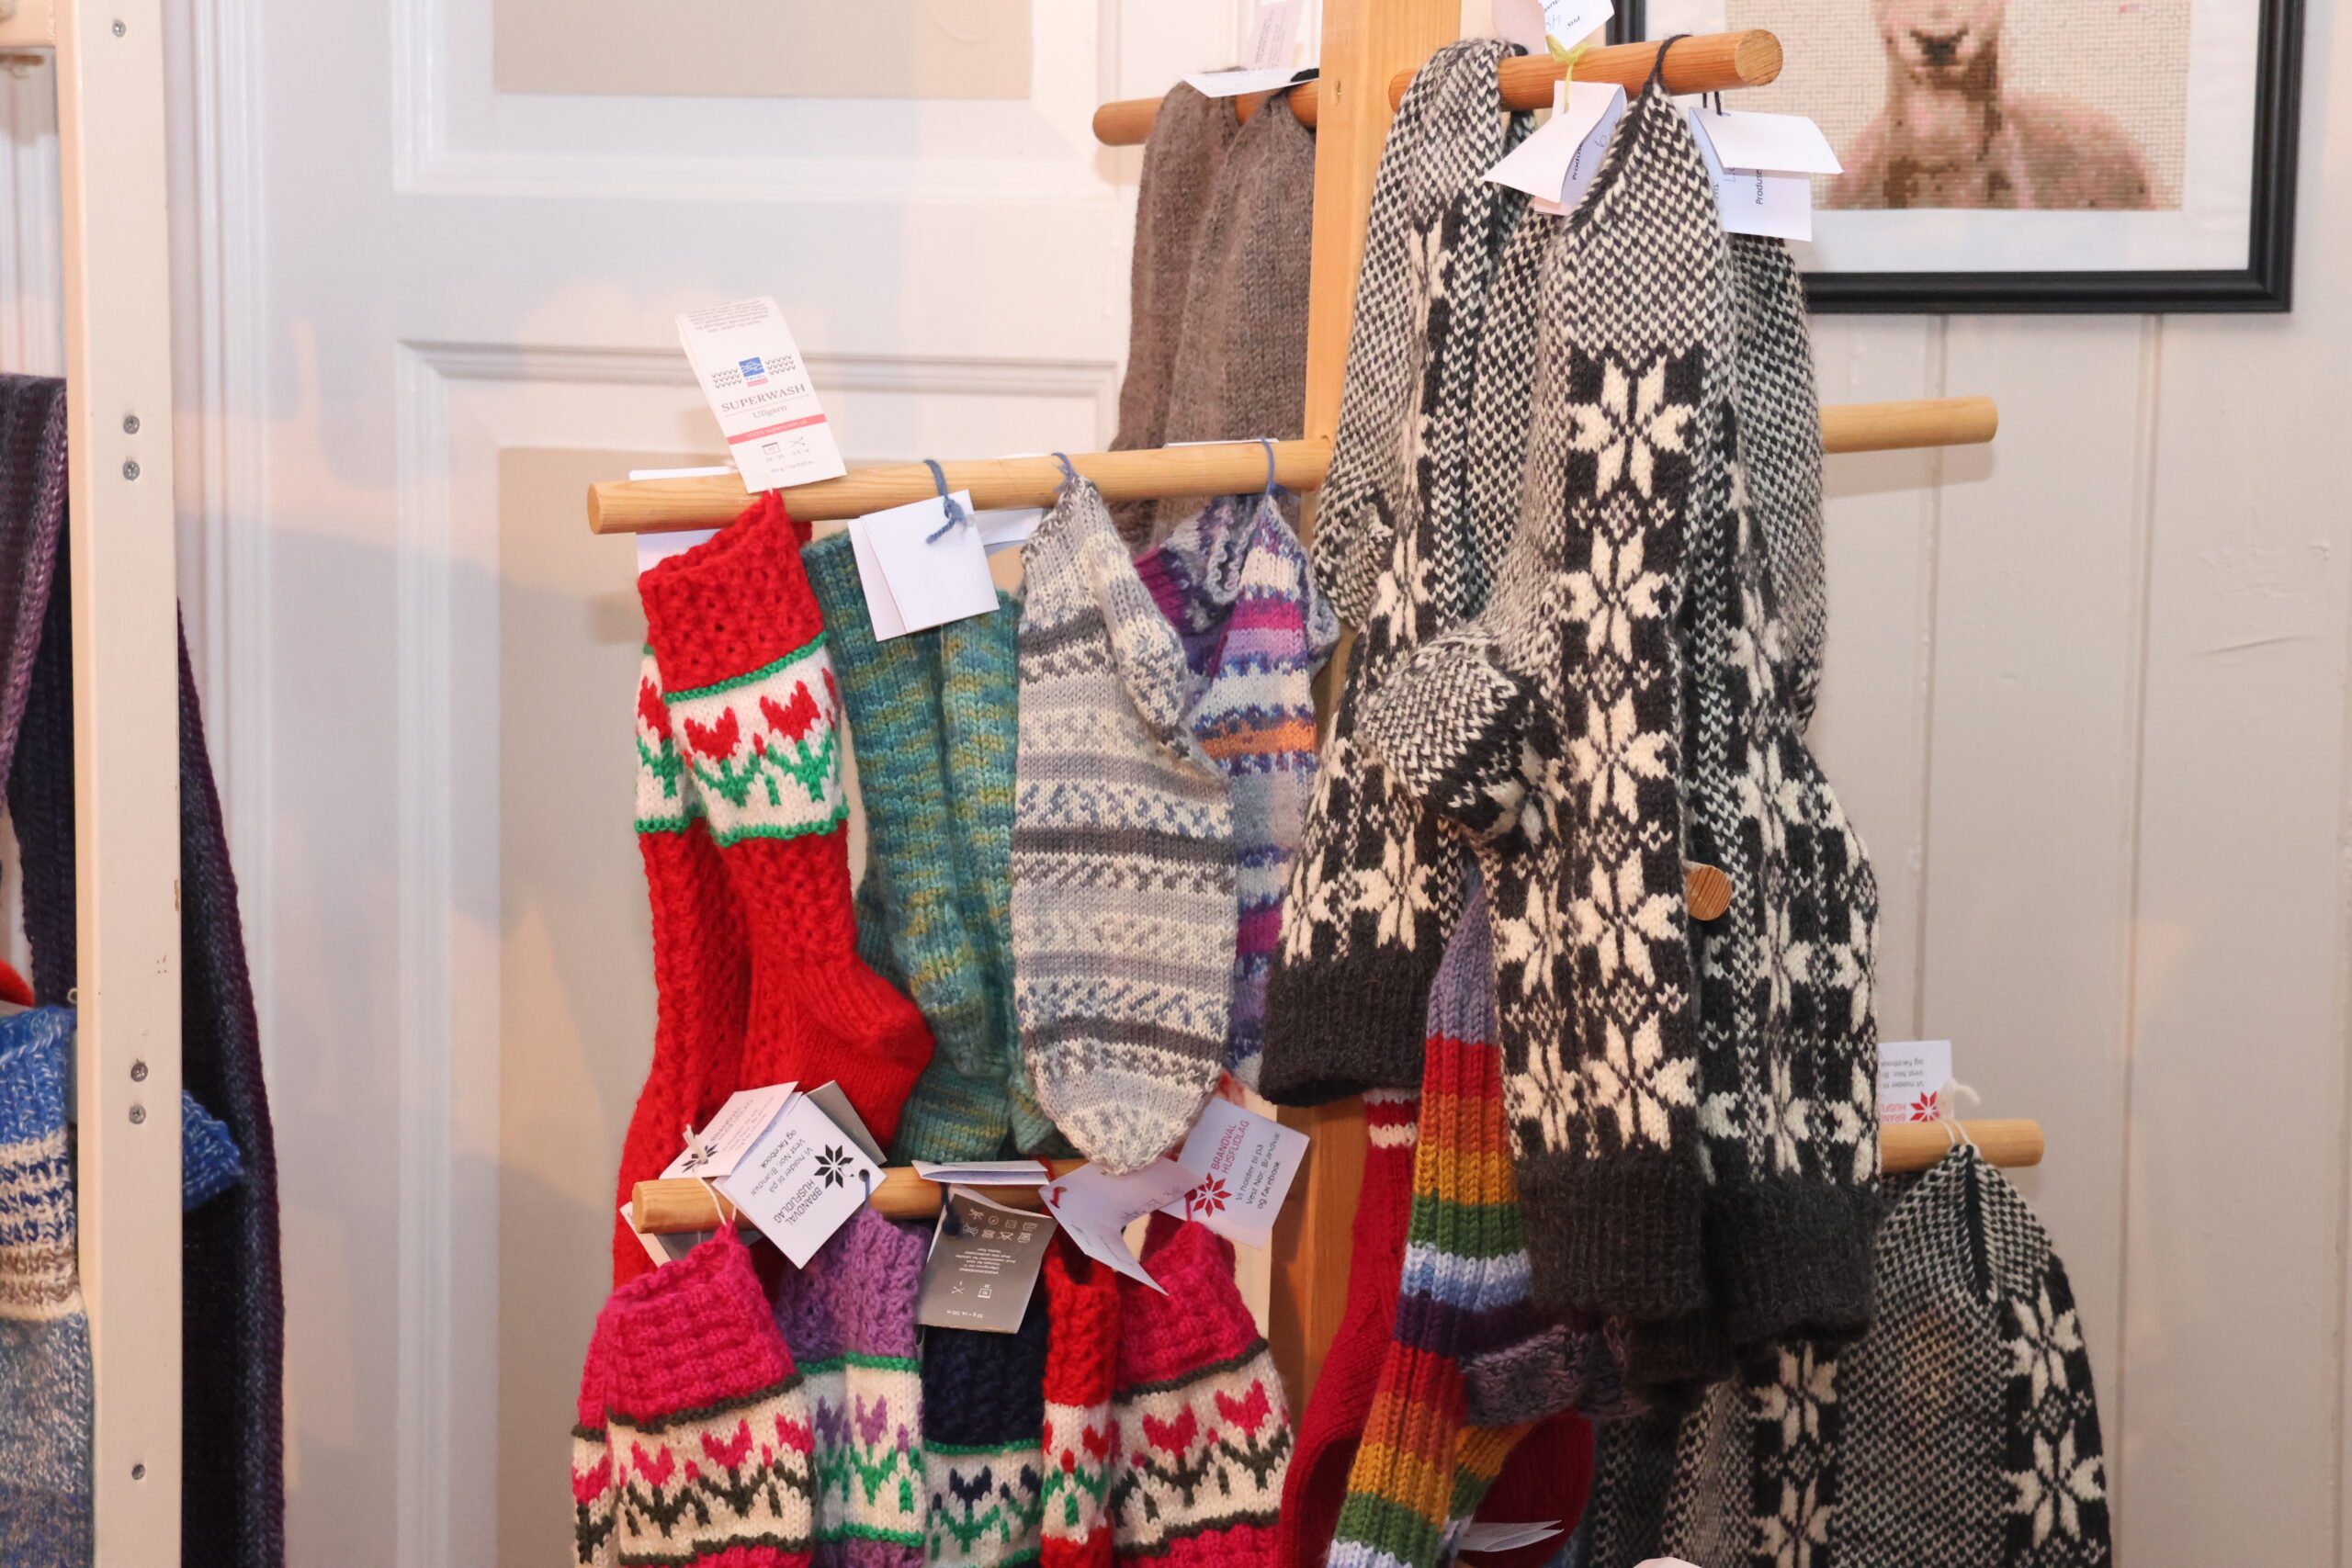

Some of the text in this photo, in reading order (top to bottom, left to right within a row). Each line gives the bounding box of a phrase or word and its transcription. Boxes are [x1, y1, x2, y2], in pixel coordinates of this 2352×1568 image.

[721, 384, 806, 412] SUPERWASH
[752, 405, 787, 419] Ullgarn
[760, 1129, 797, 1170] og facebook
[789, 1138, 806, 1155] Vest
[1211, 1122, 1237, 1170] BRANDVAL
[1221, 1120, 1250, 1174] HUSFLIDLAG
[1245, 1187, 1258, 1204] Vest
[1261, 1132, 1281, 1168] Brandval
[749, 1167, 778, 1197] Brandval
[768, 1146, 813, 1194] Vi holder til på
[1236, 1144, 1264, 1201] Vi holder til på
[1257, 1161, 1281, 1210] og facebook
[773, 1178, 815, 1224] HUSFLIDLAG
[785, 1186, 823, 1226] BRANDVAL
